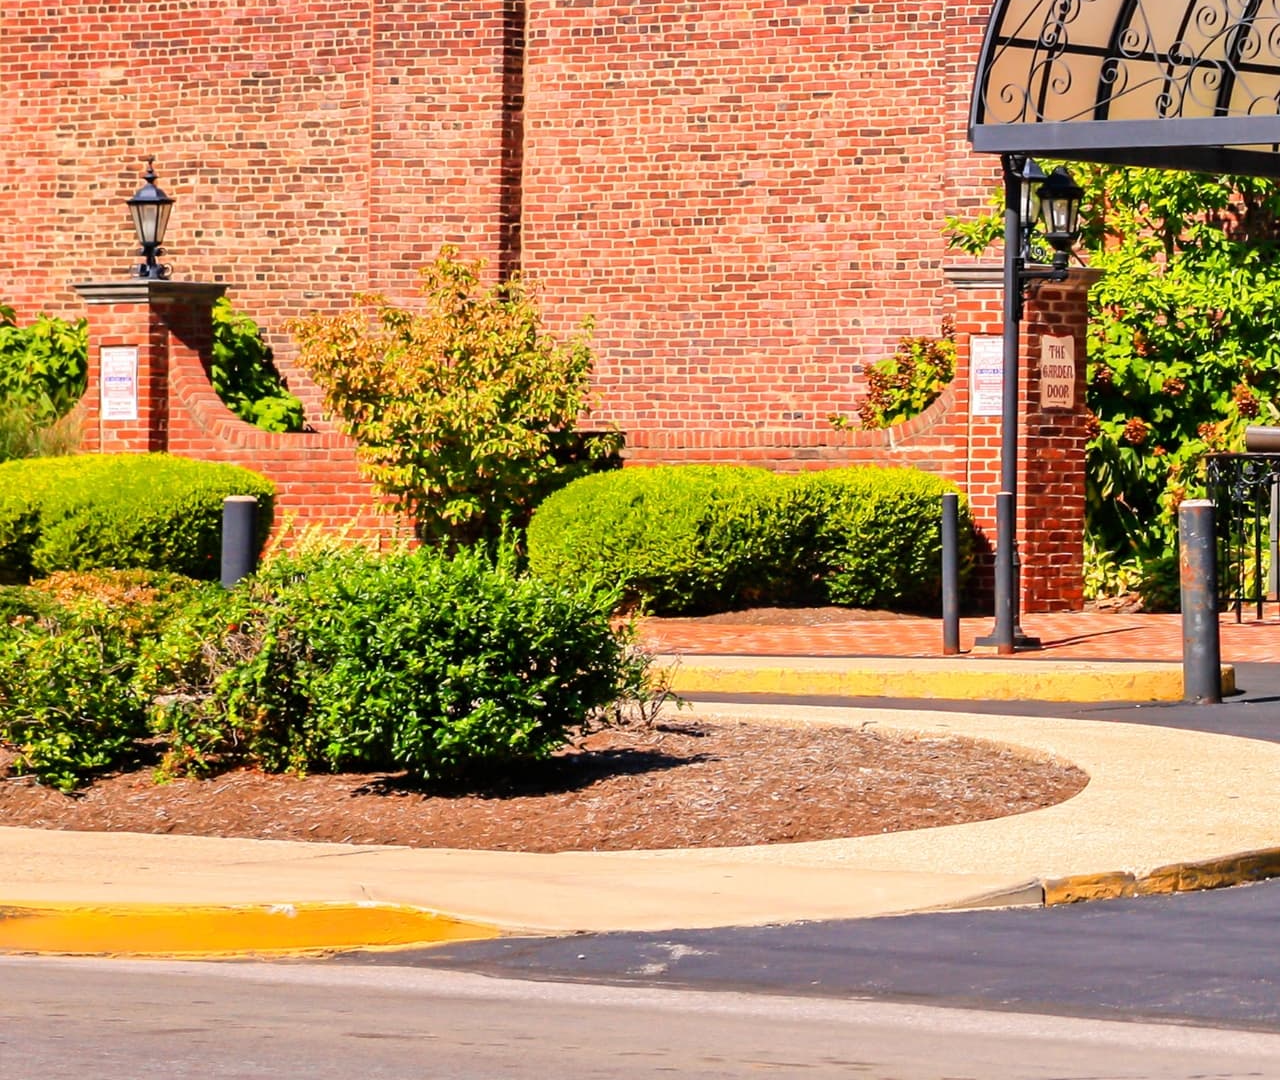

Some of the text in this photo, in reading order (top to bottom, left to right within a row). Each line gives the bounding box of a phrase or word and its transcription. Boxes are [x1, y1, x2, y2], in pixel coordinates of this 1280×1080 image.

[1049, 345, 1065, 359] THE
[1043, 365, 1073, 379] GARDEN
[1047, 385, 1069, 398] DOOR
